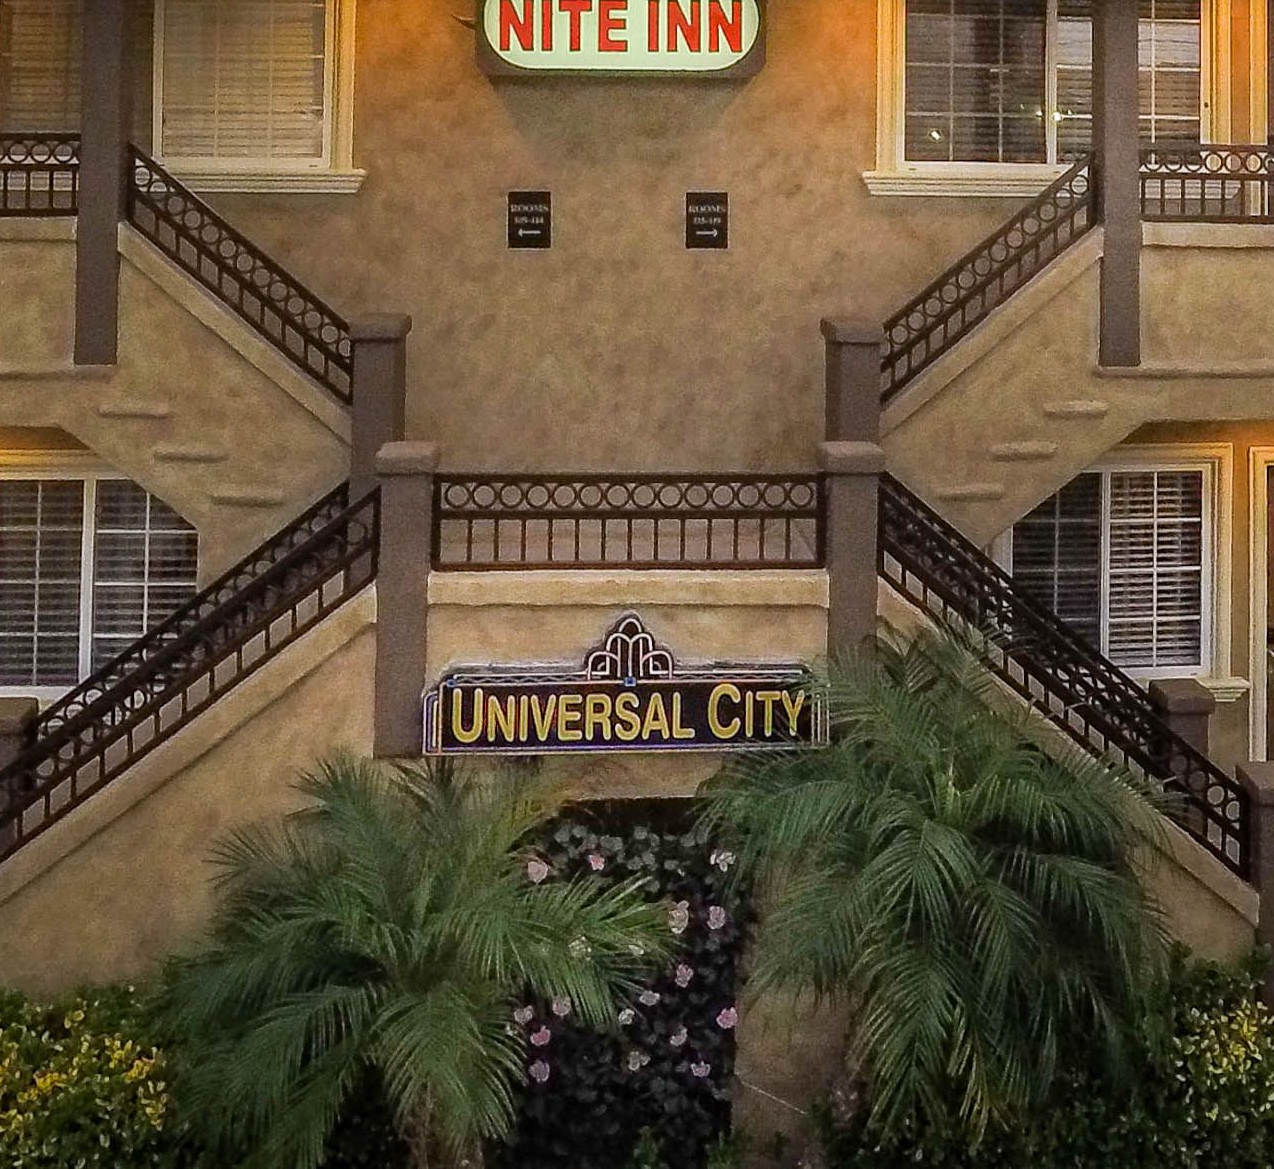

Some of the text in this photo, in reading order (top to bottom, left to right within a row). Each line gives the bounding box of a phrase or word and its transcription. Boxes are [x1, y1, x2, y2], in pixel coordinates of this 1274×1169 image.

[510, 203, 550, 213] ROOMS
[688, 204, 726, 213] ROOMS
[451, 682, 806, 744] UNIVERSAL CITY
